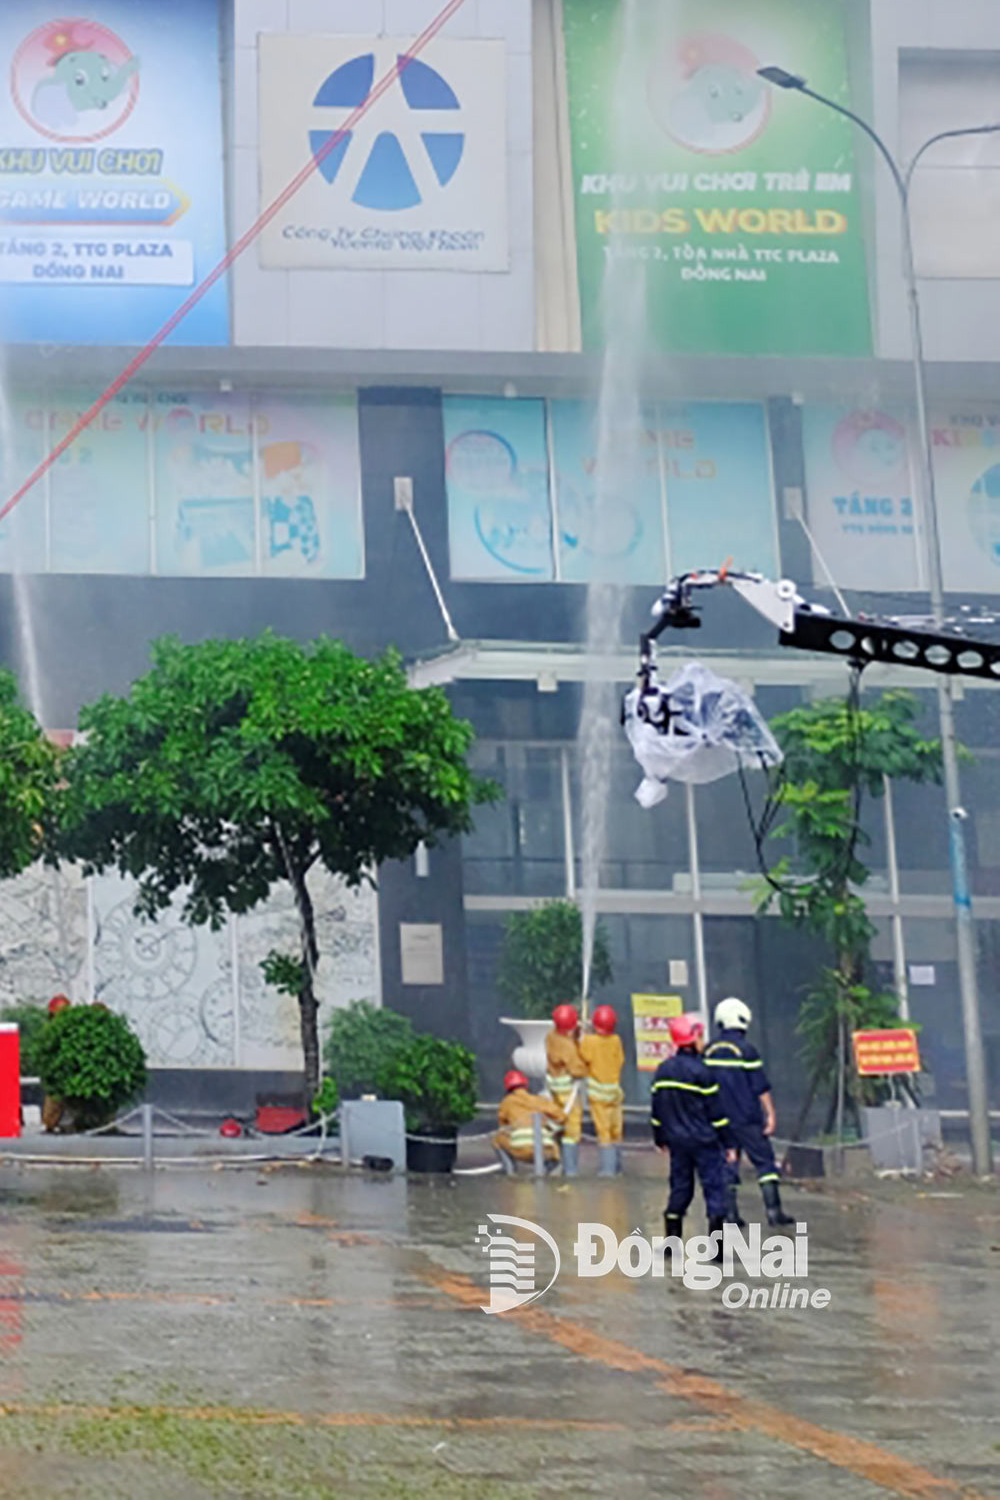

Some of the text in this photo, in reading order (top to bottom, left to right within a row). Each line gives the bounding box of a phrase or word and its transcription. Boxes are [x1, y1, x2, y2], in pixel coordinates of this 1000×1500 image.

[49, 149, 96, 176] VUI
[75, 189, 172, 210] WORLD
[593, 207, 848, 235] KIDS WORLD
[72, 243, 108, 258] TTC
[112, 243, 174, 258] PLAZA
[91, 264, 124, 279] NAI
